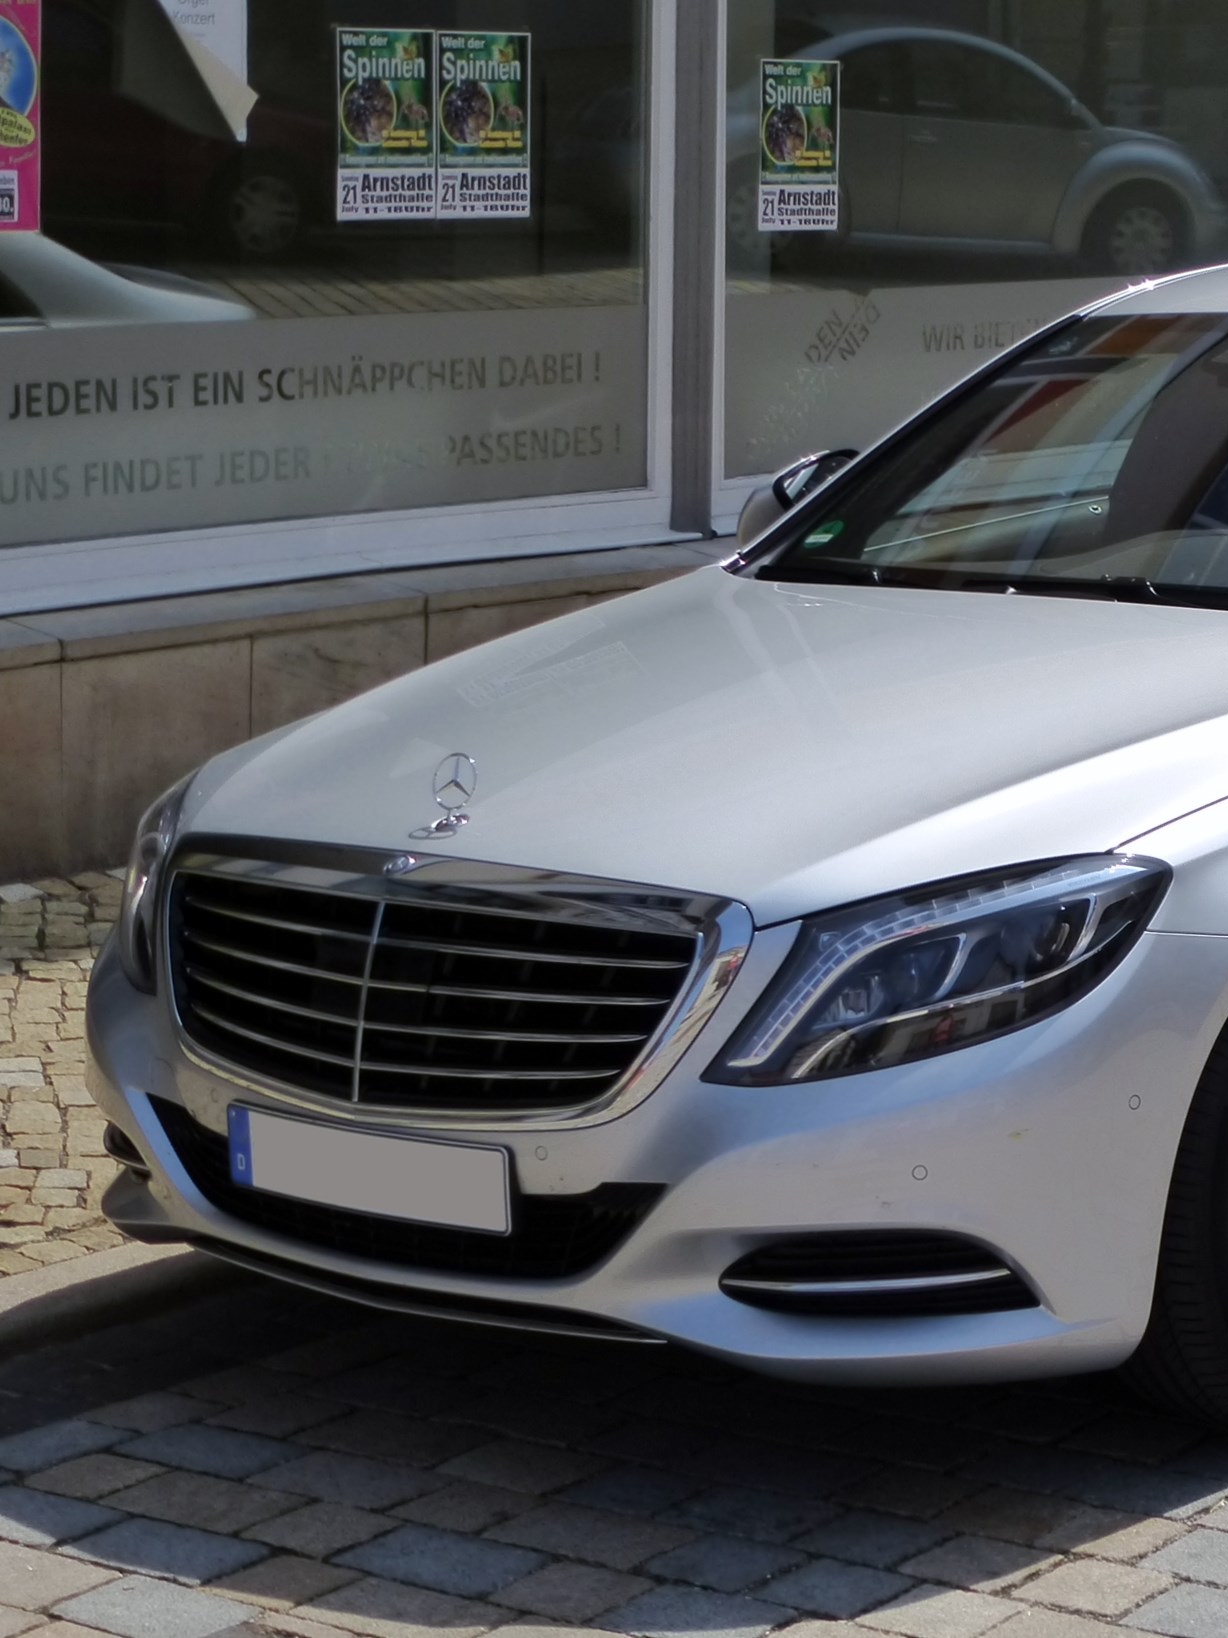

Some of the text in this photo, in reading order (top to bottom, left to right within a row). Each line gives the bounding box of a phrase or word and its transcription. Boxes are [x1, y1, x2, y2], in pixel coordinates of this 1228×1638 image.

[342, 34, 388, 46] Welt der
[441, 37, 485, 48] Welt der
[343, 49, 425, 85] Spinnen
[442, 52, 521, 87] Spinnen
[764, 64, 801, 75] Welt der
[765, 78, 831, 110] Spinnen
[361, 173, 433, 192] Arnstadt
[460, 172, 528, 191] Arnstadt
[342, 184, 357, 205] 21
[361, 192, 433, 204] Stadthalle
[442, 183, 456, 203] 21
[459, 192, 528, 202] Stadthalle
[778, 189, 836, 206] Arnstadt
[763, 198, 774, 216] 21
[778, 207, 836, 216] Stadthalle
[922, 322, 965, 352] WIR
[9, 378, 118, 420] JEDEN
[132, 374, 180, 410] IST
[193, 370, 244, 407] EIN
[257, 355, 486, 402] SCHNÄPPCHEN
[498, 352, 582, 388] DABEI
[0, 464, 70, 504] UNS
[84, 454, 203, 497] FINDET
[214, 445, 311, 487] JEDER
